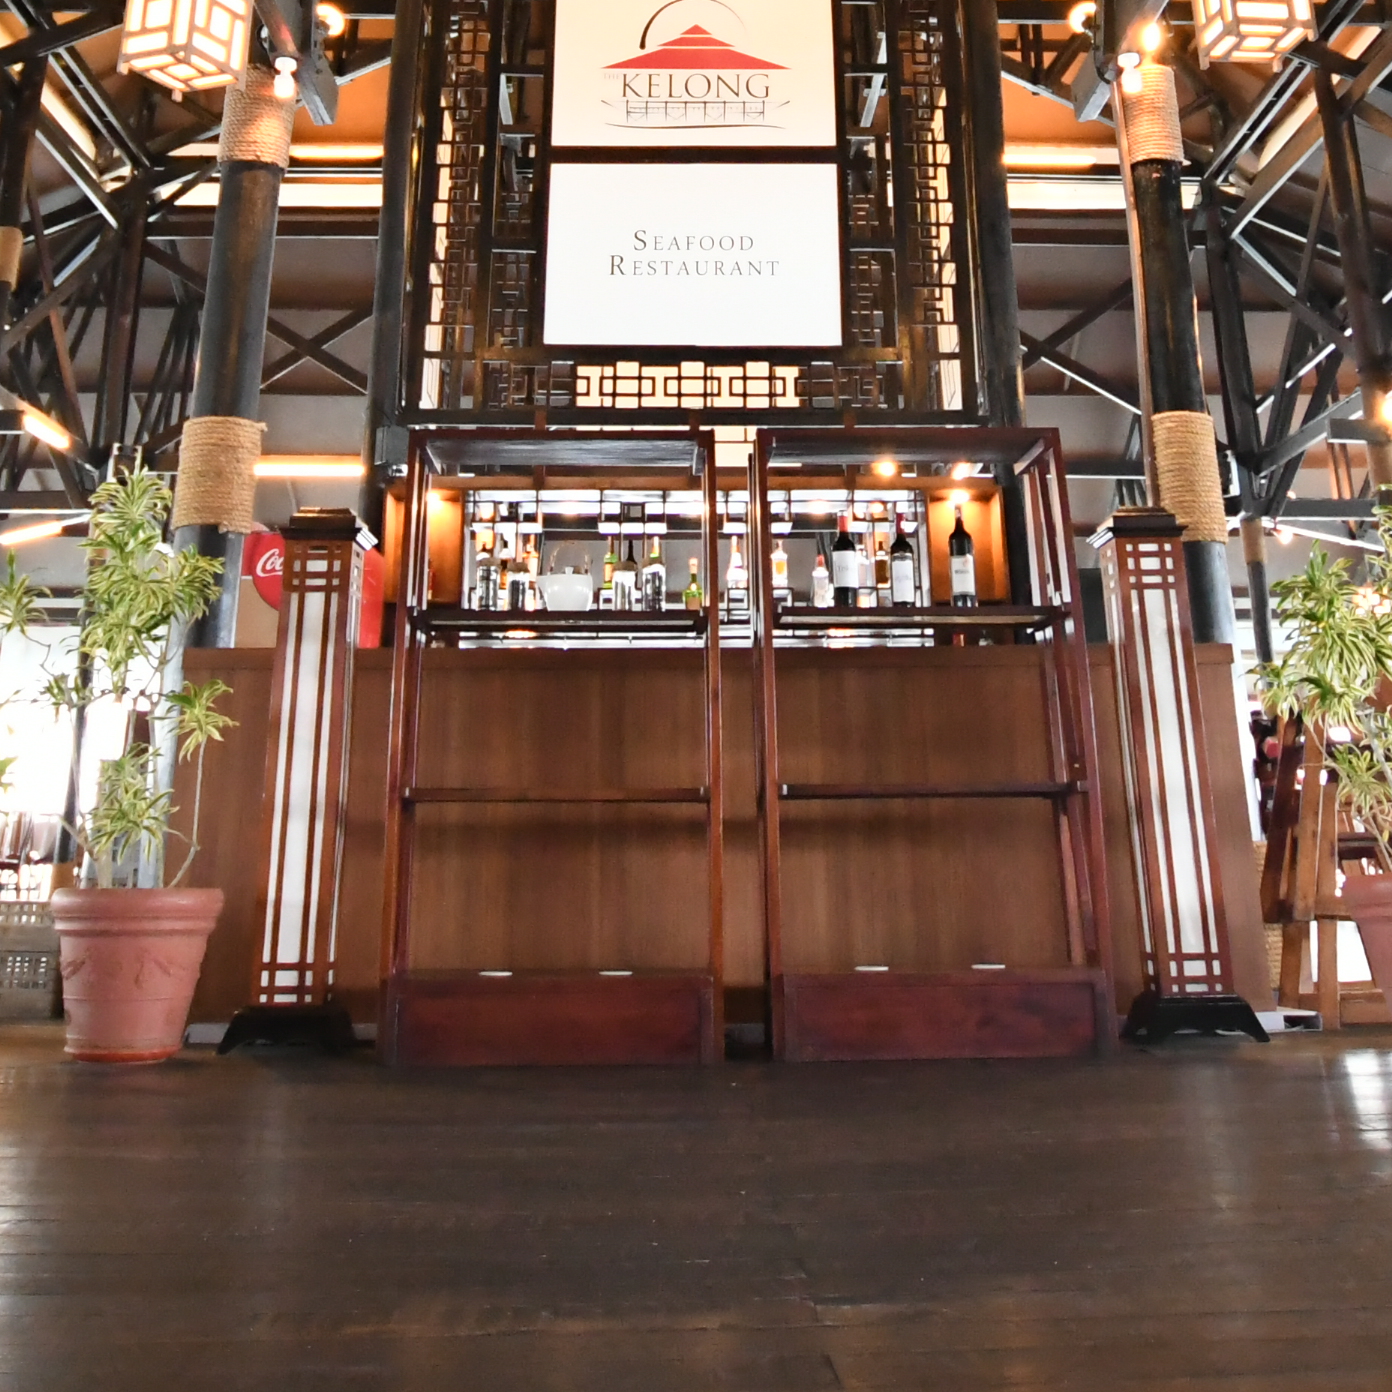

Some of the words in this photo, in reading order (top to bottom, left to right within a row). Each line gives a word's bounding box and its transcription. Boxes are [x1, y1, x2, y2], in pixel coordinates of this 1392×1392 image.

[622, 73, 770, 99] KELONG
[633, 229, 754, 251] SEAFOOD
[609, 254, 780, 276] RESTAURANT
